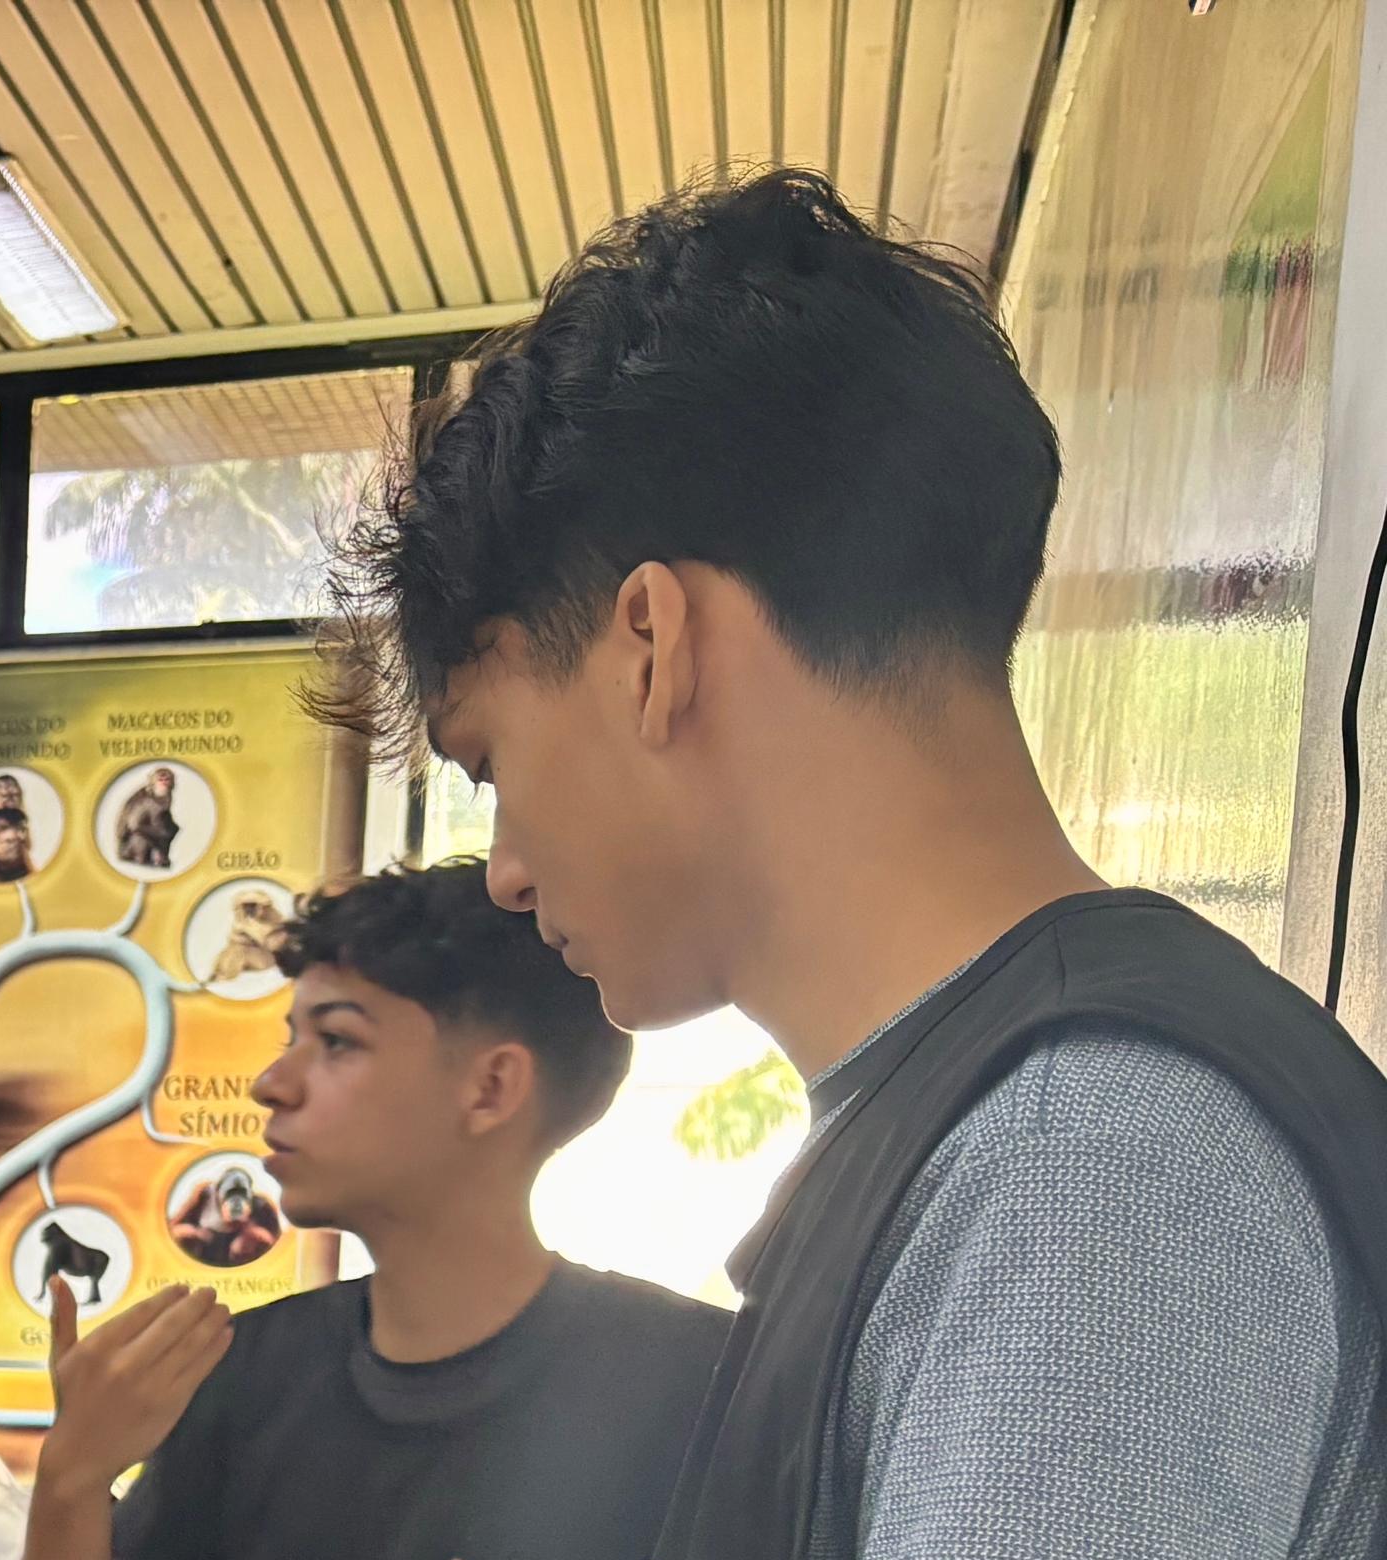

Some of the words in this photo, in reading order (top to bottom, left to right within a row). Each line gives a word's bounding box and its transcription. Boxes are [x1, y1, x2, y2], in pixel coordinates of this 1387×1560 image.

[107, 711, 200, 731] MACACOS
[203, 707, 235, 729] DO
[167, 734, 244, 753] MUNDO
